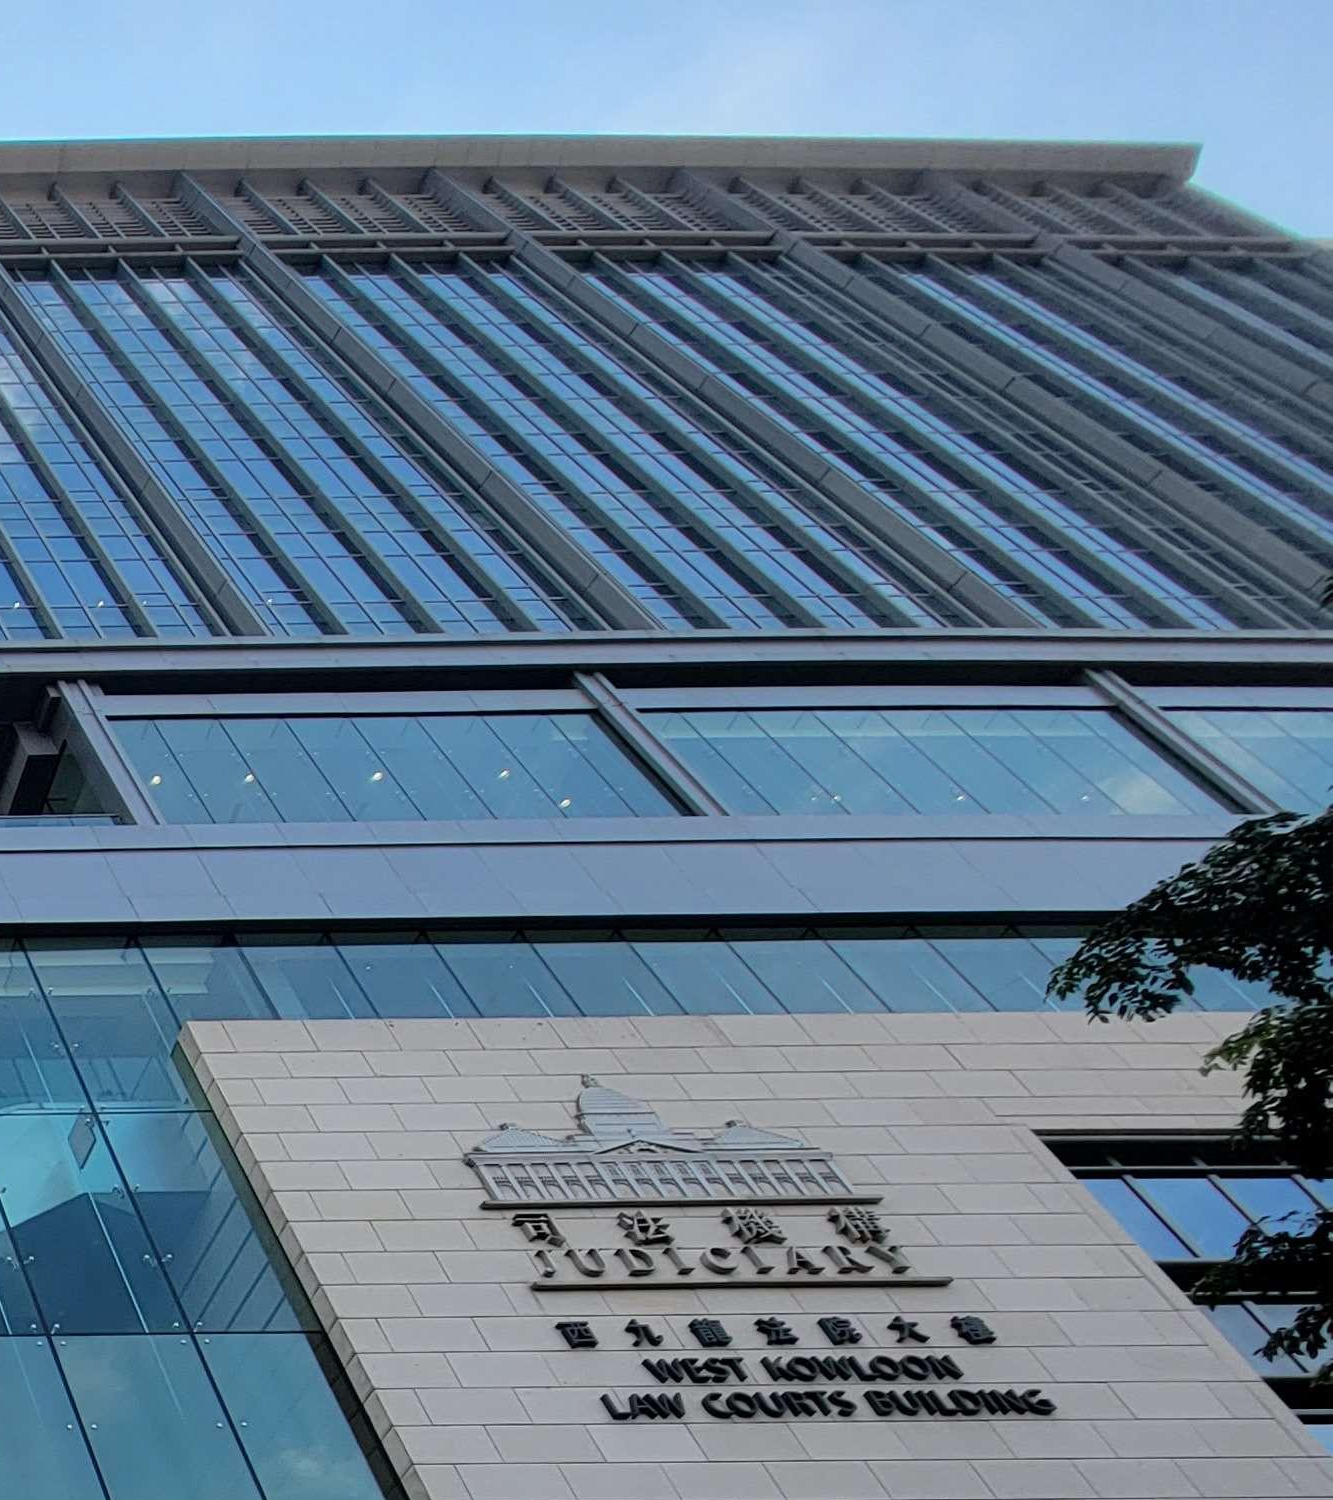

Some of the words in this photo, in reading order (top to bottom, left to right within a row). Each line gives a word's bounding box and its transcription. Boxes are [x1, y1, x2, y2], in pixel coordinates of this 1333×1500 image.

[512, 1207, 891, 1248] 司法機構
[533, 1246, 912, 1278] JUDICIARY
[555, 1315, 997, 1348] 西九龍法院大樓
[641, 1356, 748, 1384] WEST
[760, 1354, 964, 1383] KOWLOON
[599, 1392, 685, 1420] LAW
[701, 1390, 858, 1419] COURTS
[863, 1388, 1058, 1417] BUILDING
